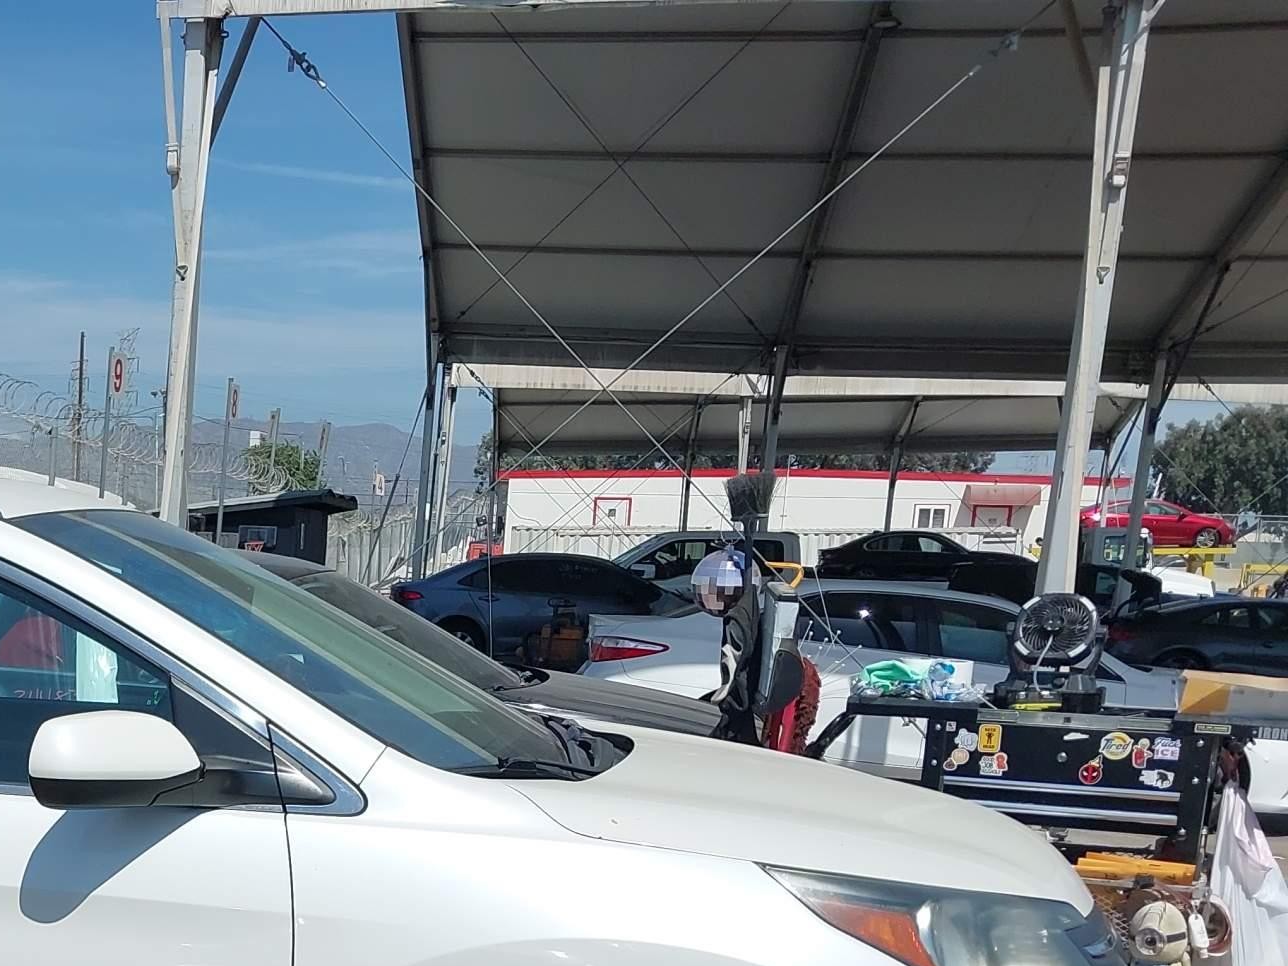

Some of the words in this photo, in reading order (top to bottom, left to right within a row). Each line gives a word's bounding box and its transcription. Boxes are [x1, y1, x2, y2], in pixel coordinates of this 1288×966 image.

[114, 358, 123, 393] 9
[230, 388, 238, 418] 8
[1101, 737, 1132, 752] Tired
[1155, 748, 1178, 757] ICE
